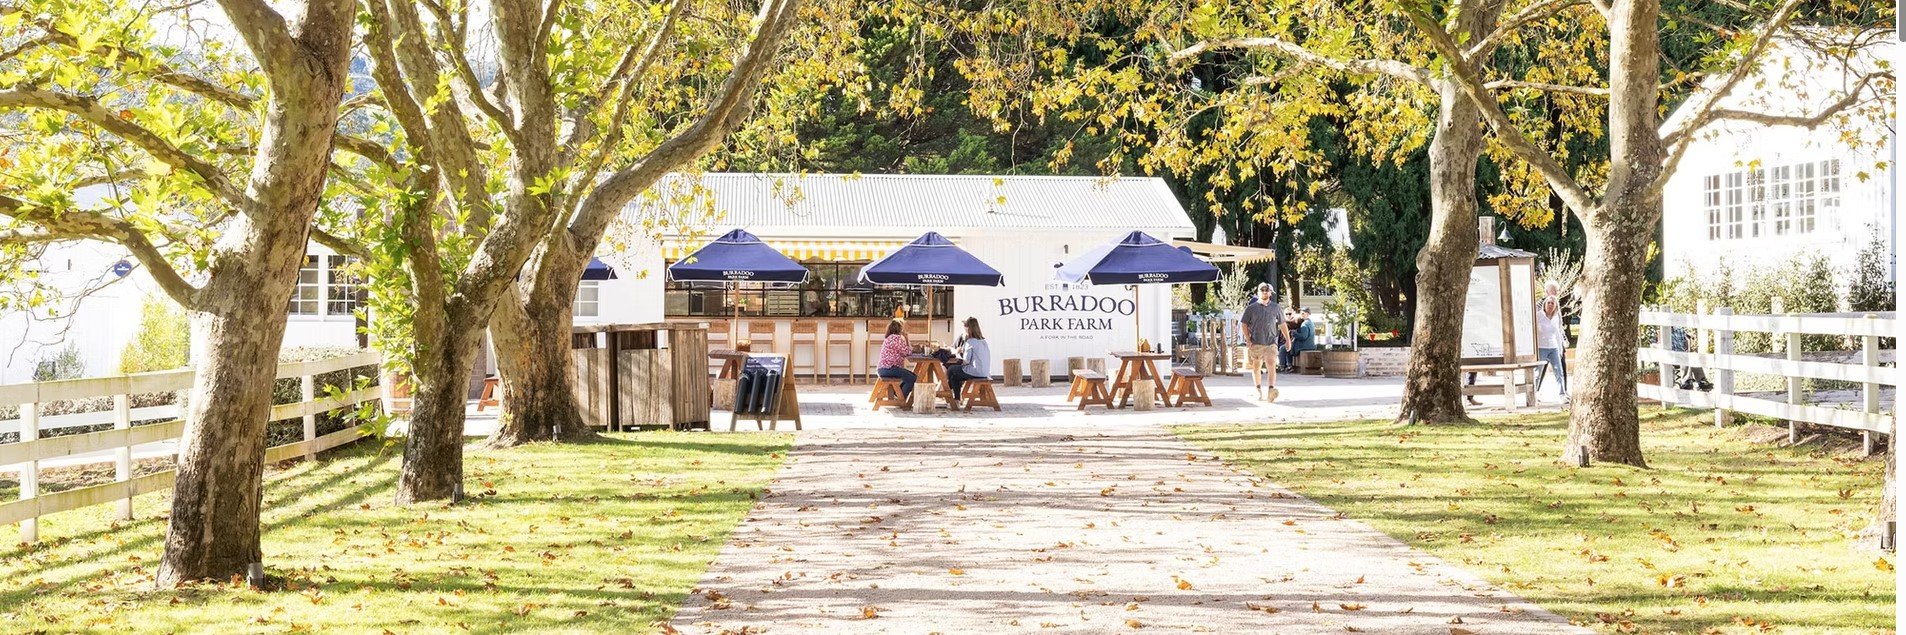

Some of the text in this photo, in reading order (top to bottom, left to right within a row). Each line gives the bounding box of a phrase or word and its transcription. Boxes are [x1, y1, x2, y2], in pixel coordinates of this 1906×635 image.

[998, 294, 1135, 316] BURRADOO
[1020, 318, 1113, 330] PARK FARM
